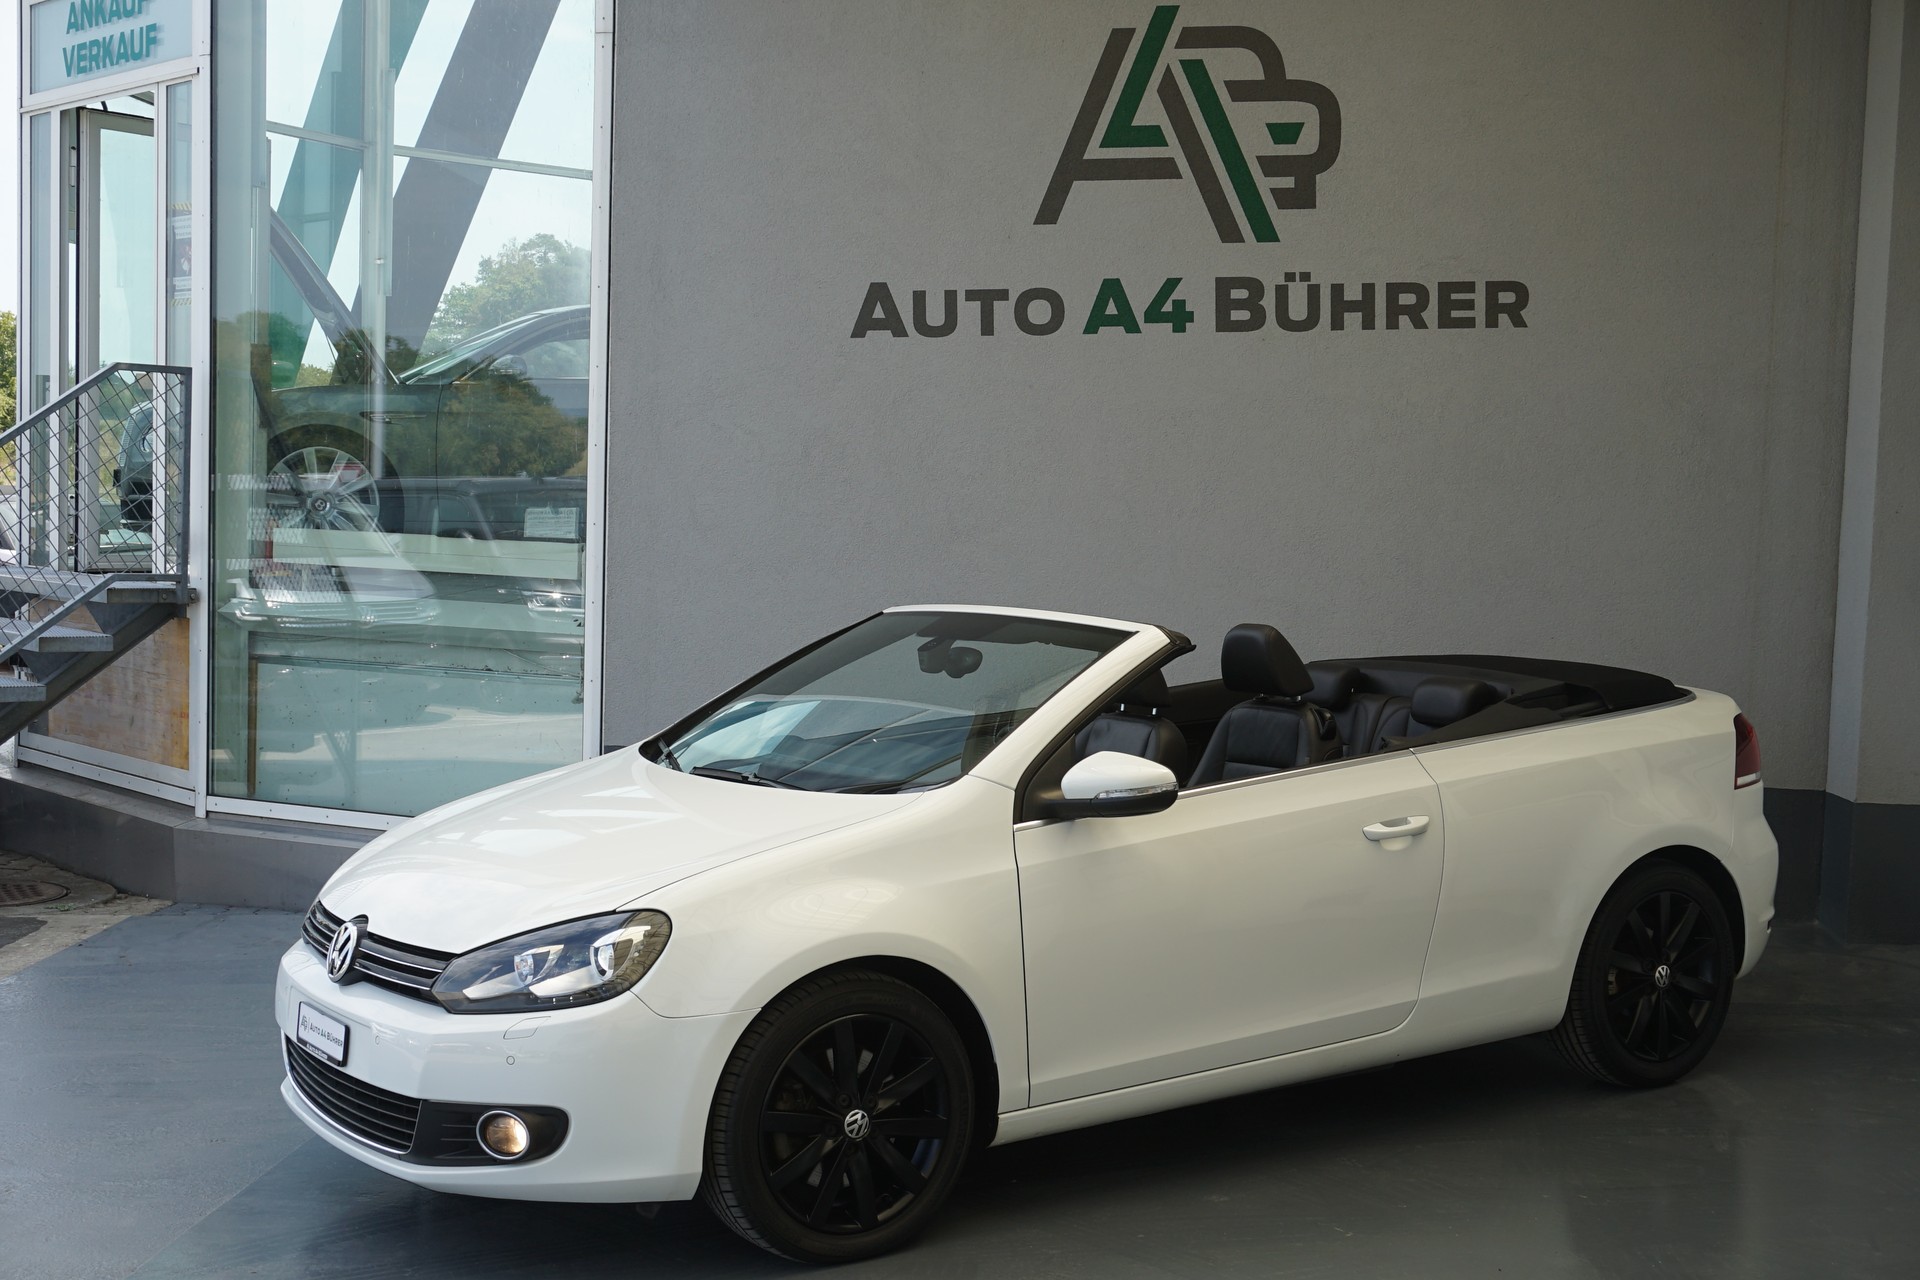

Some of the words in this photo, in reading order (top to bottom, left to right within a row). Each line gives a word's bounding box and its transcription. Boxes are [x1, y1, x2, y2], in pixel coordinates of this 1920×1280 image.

[62, 23, 157, 77] VERKAUF
[850, 281, 1066, 338] AUTO
[1082, 277, 1194, 334] A4
[1214, 272, 1530, 332] BÜHRER
[310, 1022, 320, 1035] AUTO
